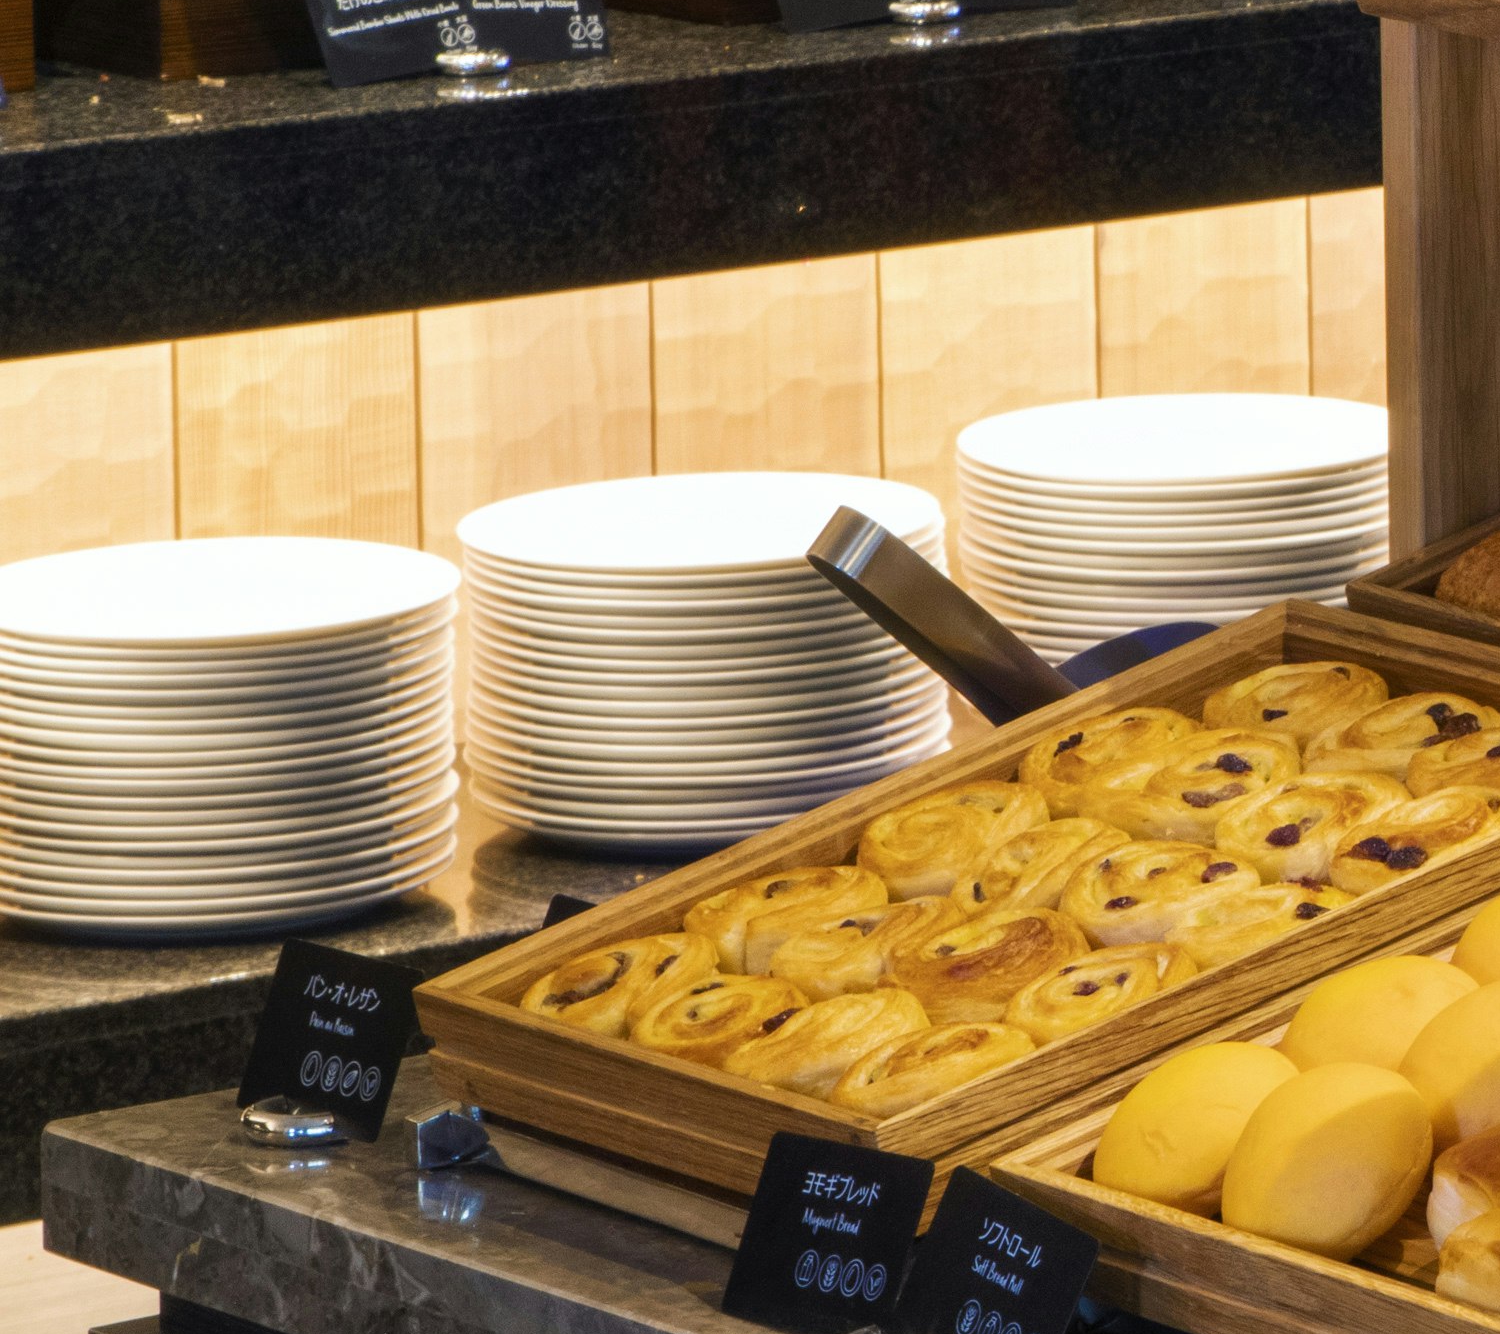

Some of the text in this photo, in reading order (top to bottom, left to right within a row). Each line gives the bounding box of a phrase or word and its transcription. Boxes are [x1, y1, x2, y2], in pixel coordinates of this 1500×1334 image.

[802, 1171, 881, 1206] ヨモギブレッド
[837, 1213, 862, 1236] Bread
[978, 1217, 1042, 1268] ソフトロール
[971, 1254, 991, 1276] Soft
[986, 1261, 1010, 1289] Bread
